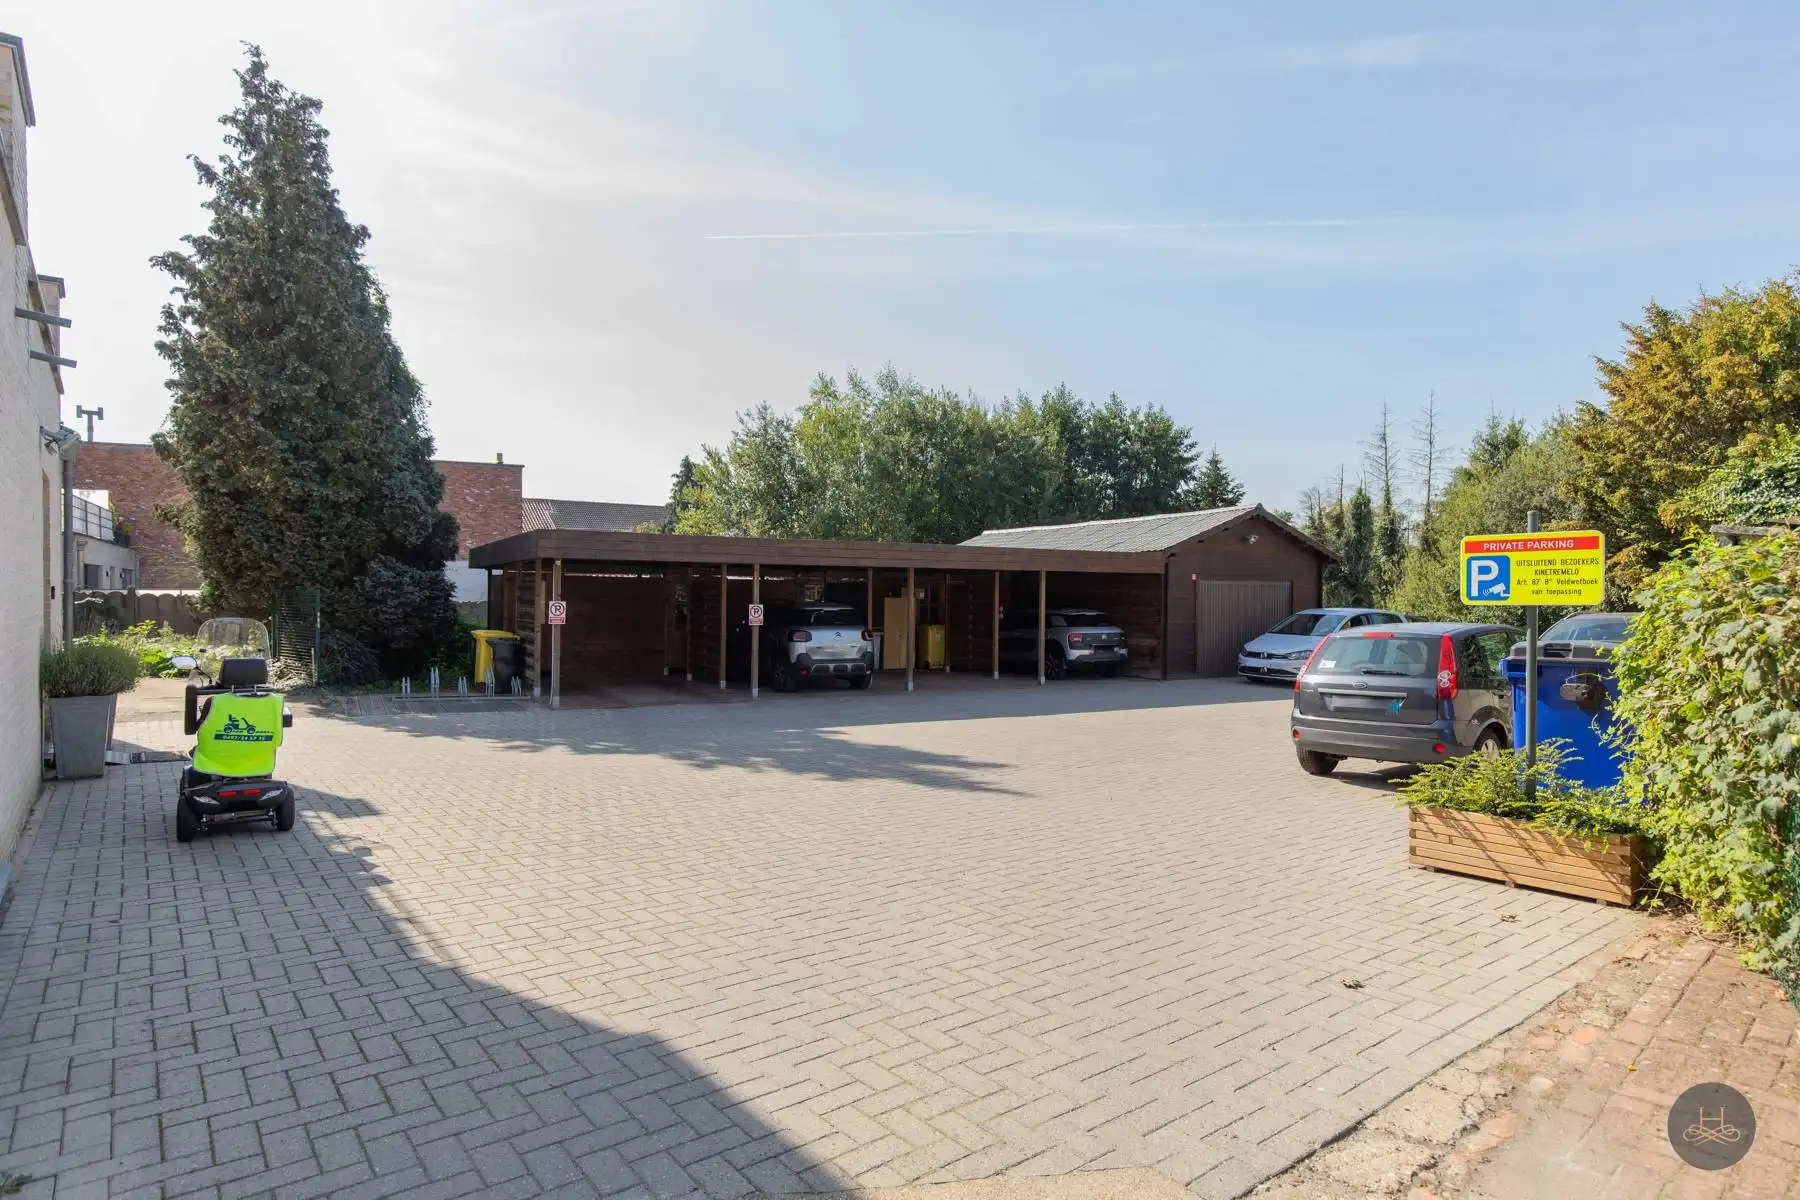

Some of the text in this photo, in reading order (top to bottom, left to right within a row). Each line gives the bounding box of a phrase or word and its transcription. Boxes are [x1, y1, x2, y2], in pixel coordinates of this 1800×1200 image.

[1483, 539, 1574, 551] PRIVATE PARKING
[1516, 558, 1599, 567] UITSLUITEND BEZOEKERS
[1470, 559, 1499, 597] P
[1516, 578, 1528, 586] Art.
[1546, 588, 1582, 596] toepassing
